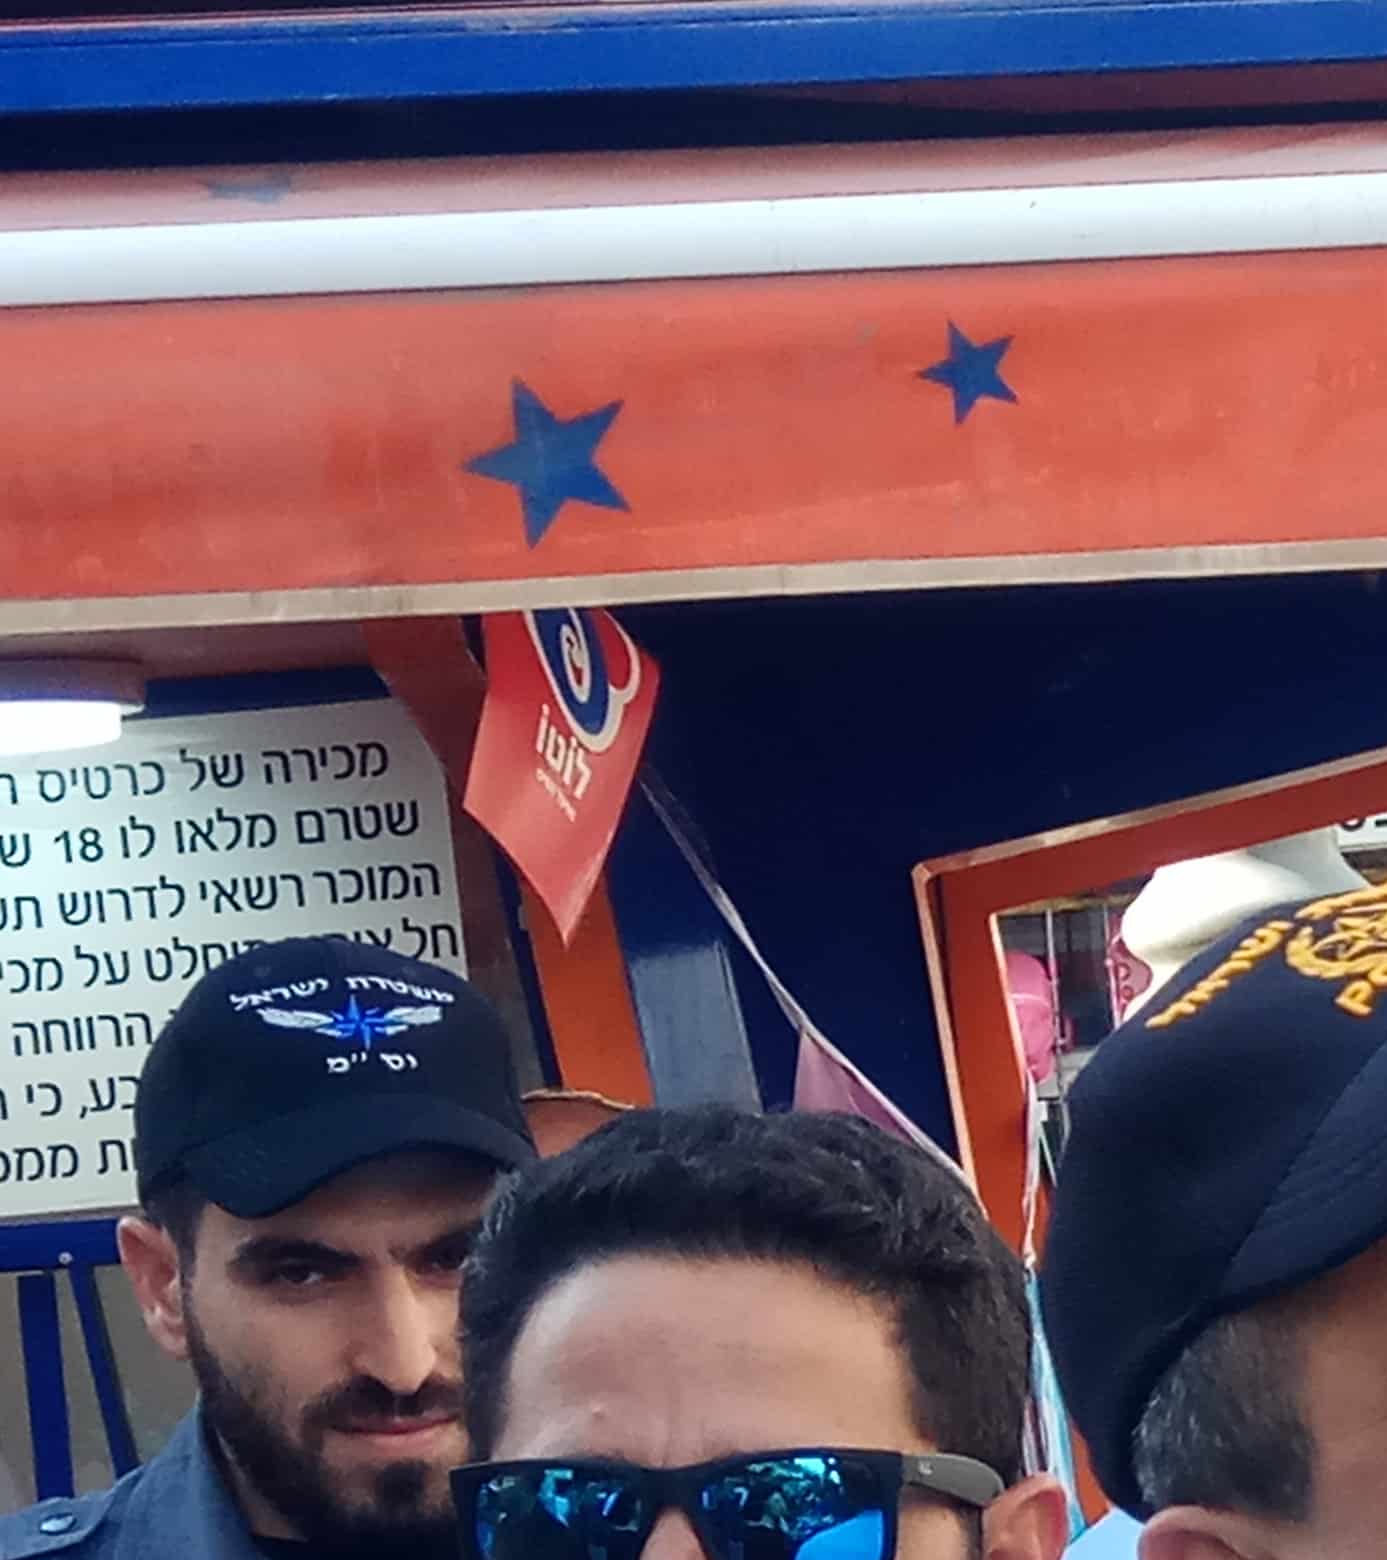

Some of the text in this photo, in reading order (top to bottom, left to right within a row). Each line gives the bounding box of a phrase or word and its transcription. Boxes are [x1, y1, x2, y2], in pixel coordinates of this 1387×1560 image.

[37, 760, 166, 802] כרטיס
[180, 748, 245, 792] של
[263, 741, 388, 785] מכירה
[120, 815, 156, 859] לו
[175, 807, 277, 854] מלאו
[295, 799, 418, 845] שטרם
[54, 828, 103, 863] 18
[58, 875, 186, 926] לדרוש
[199, 873, 303, 914] רשאי
[313, 862, 441, 907] המוכר
[144, 936, 262, 981] חלט
[401, 917, 458, 961] חל
[74, 945, 131, 988] על
[229, 977, 330, 1012] ישראל
[12, 1012, 153, 1056] הרווחה
[26, 1083, 63, 1117] כי
